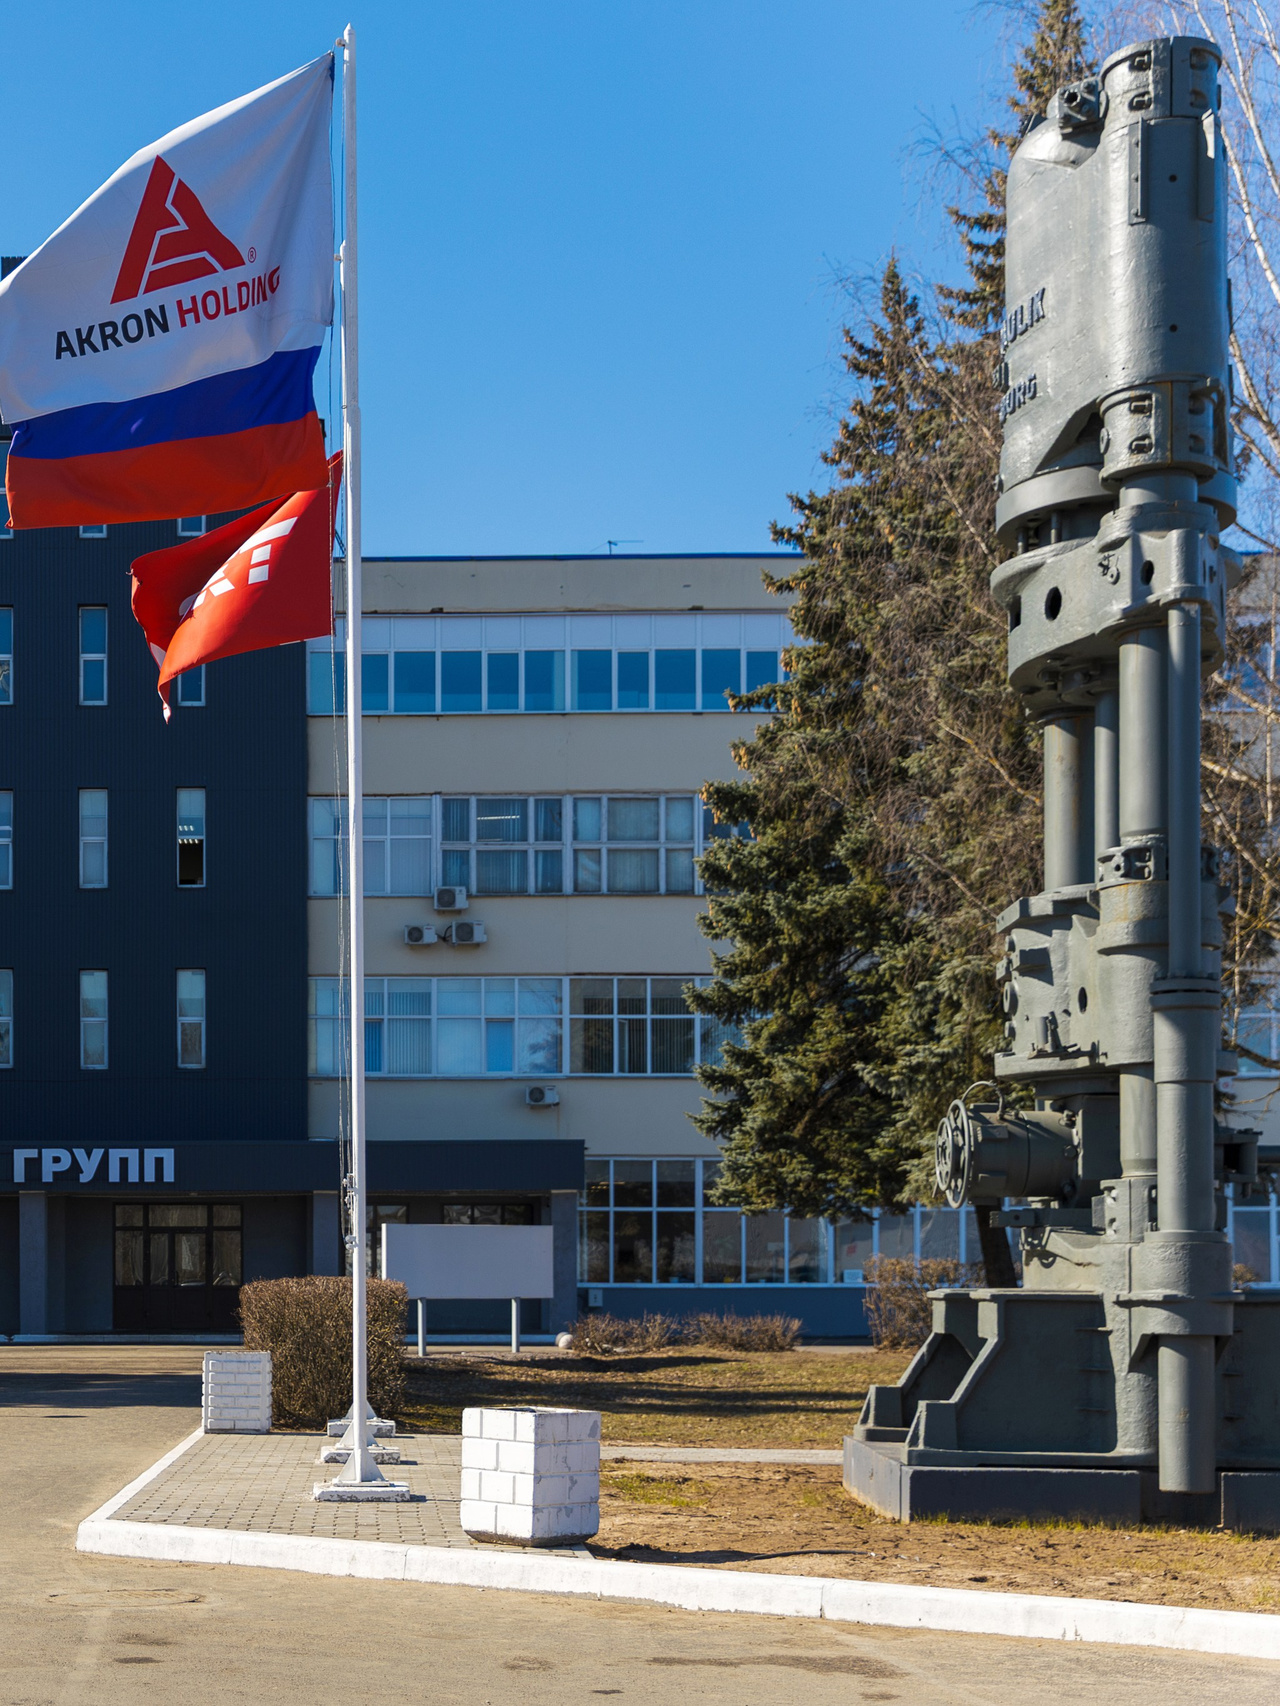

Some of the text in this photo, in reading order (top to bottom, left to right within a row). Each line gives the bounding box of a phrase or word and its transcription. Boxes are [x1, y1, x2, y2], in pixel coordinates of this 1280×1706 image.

[54, 264, 281, 360] AKRON HOLDING
[12, 1147, 176, 1184] ГРУПП
